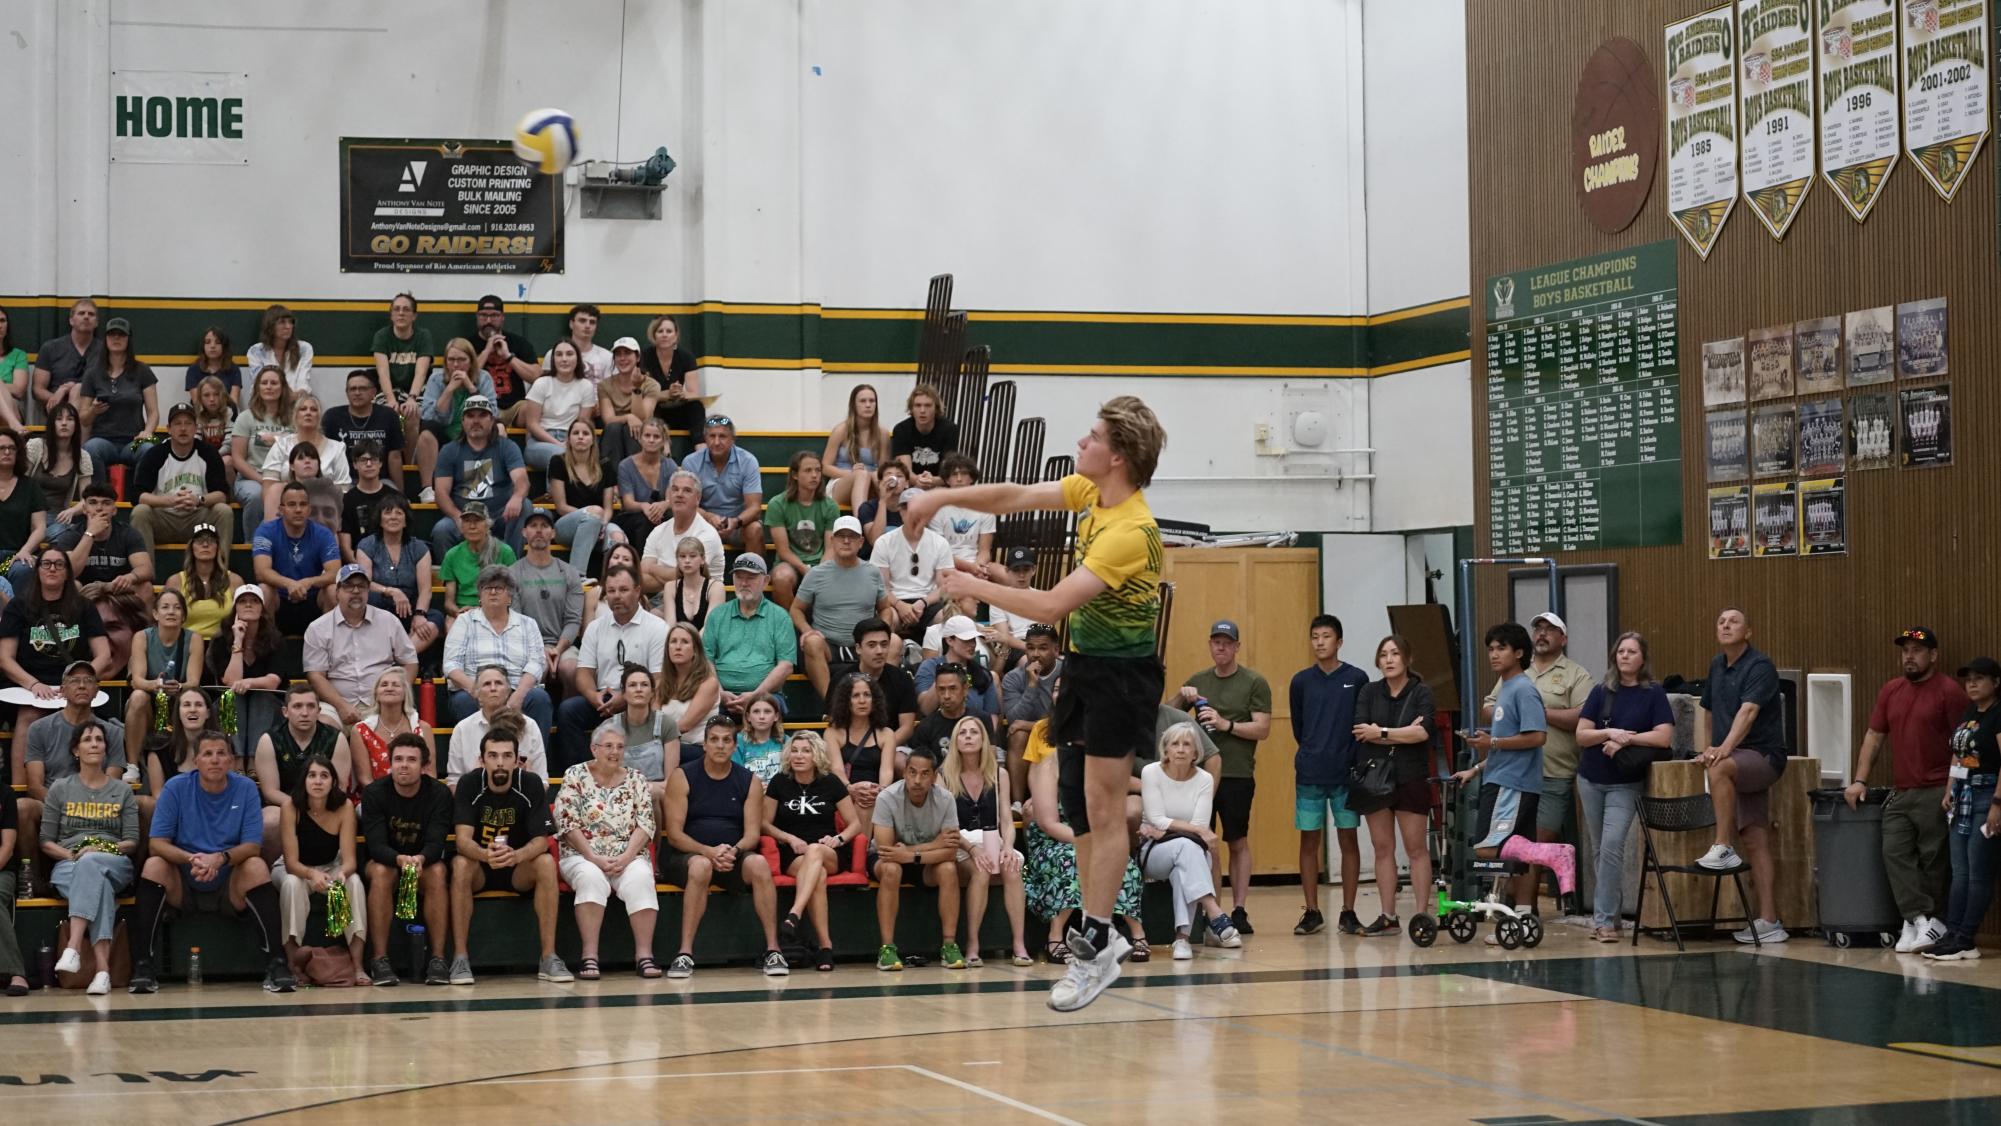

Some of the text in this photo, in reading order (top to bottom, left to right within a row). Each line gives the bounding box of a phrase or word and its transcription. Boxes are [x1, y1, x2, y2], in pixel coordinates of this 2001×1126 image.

[1753, 7, 1798, 41] RAIDERS
[1678, 34, 1721, 67] RAIDERS
[1907, 43, 1929, 91] BOYS
[1929, 26, 1985, 70] BASKETBALL
[1823, 67, 1842, 115] BOYS
[1843, 54, 1895, 96] BASKETBALL
[1744, 93, 1763, 138] BOYS
[1763, 79, 1811, 119] BASKETBALL
[1846, 92, 1872, 113] 1996
[116, 95, 243, 139] HOME
[1766, 116, 1789, 136] 1991
[1671, 104, 1733, 159] BOYS BASKETBALL
[1588, 125, 1627, 159] RAIDER
[1691, 139, 1712, 158] 1985
[451, 165, 528, 176] GRAPHIC DESIGN
[448, 178, 532, 189] CUSTOM PRINTING
[377, 199, 446, 208] ANTHONY VAN NOTE
[457, 191, 522, 202] BULK MAILING
[463, 204, 517, 215] SINCE 2005
[371, 222, 481, 232] AnthonyVanNoteDesigns@gmail.com
[370, 235, 535, 255] GO RAIDERS!
[373, 262, 395, 270] Proud
[396, 262, 423, 271] Sponsor
[424, 262, 433, 270] of
[433, 262, 447, 270] Rio
[448, 262, 485, 270] Americano
[1530, 256, 1637, 290] LEAGUE CHAMPIONS
[1533, 276, 1634, 309] BOYS BASKETBALL
[193, 522, 216, 534] RIO
[66, 802, 121, 819] RAIDERS
